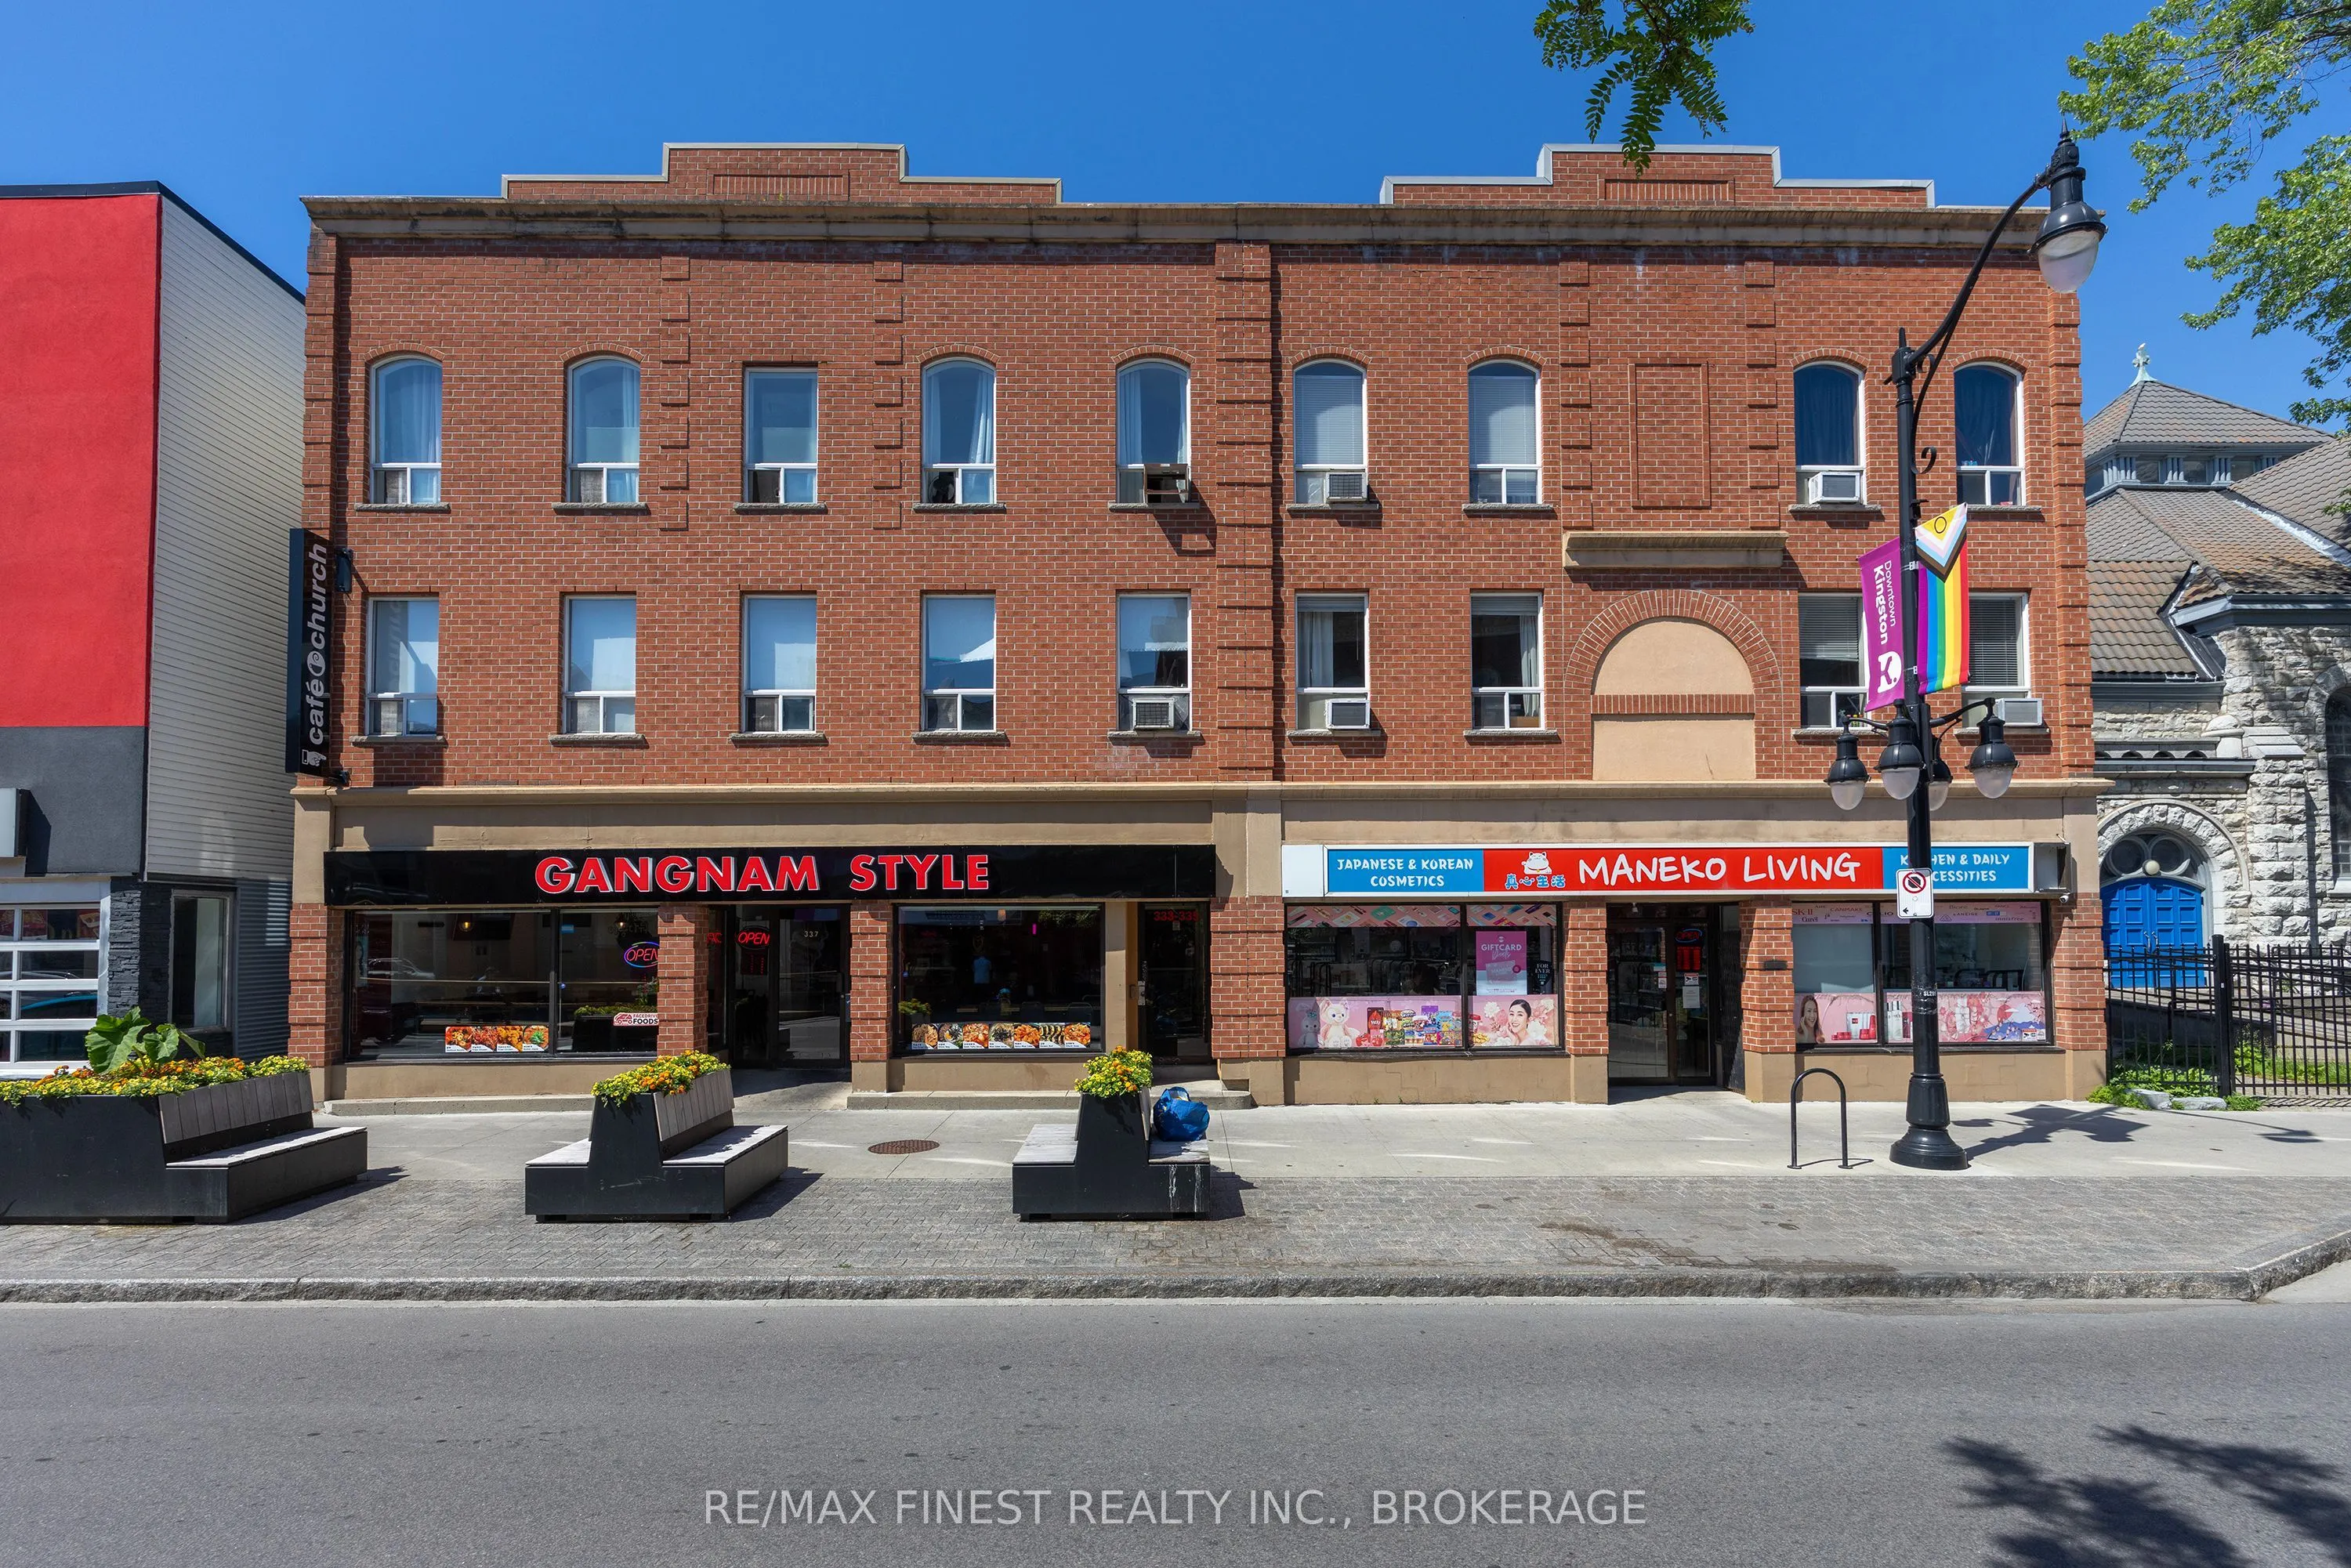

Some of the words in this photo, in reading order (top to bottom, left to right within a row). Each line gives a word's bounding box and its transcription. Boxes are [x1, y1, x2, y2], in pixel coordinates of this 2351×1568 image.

[307, 544, 327, 650] church
[1884, 559, 1896, 627] Downtown
[1874, 564, 1888, 645] Kingston
[1337, 858, 1404, 871] JAPANESE
[1408, 859, 1417, 870] &
[1421, 858, 1473, 870] KOREAN
[1900, 854, 1955, 865] KHEN
[1960, 854, 1969, 865] &
[1973, 854, 2010, 865] DAILY
[535, 855, 820, 893] GANGNAM
[849, 854, 989, 890] STYLE
[1579, 853, 1726, 885] MANEKO
[1744, 853, 1860, 883] LIVING
[1933, 871, 1996, 882] CESSITIES
[1370, 875, 1444, 887] COSMETICS
[1505, 873, 1566, 889] 真心生活
[737, 932, 770, 945] OPEN
